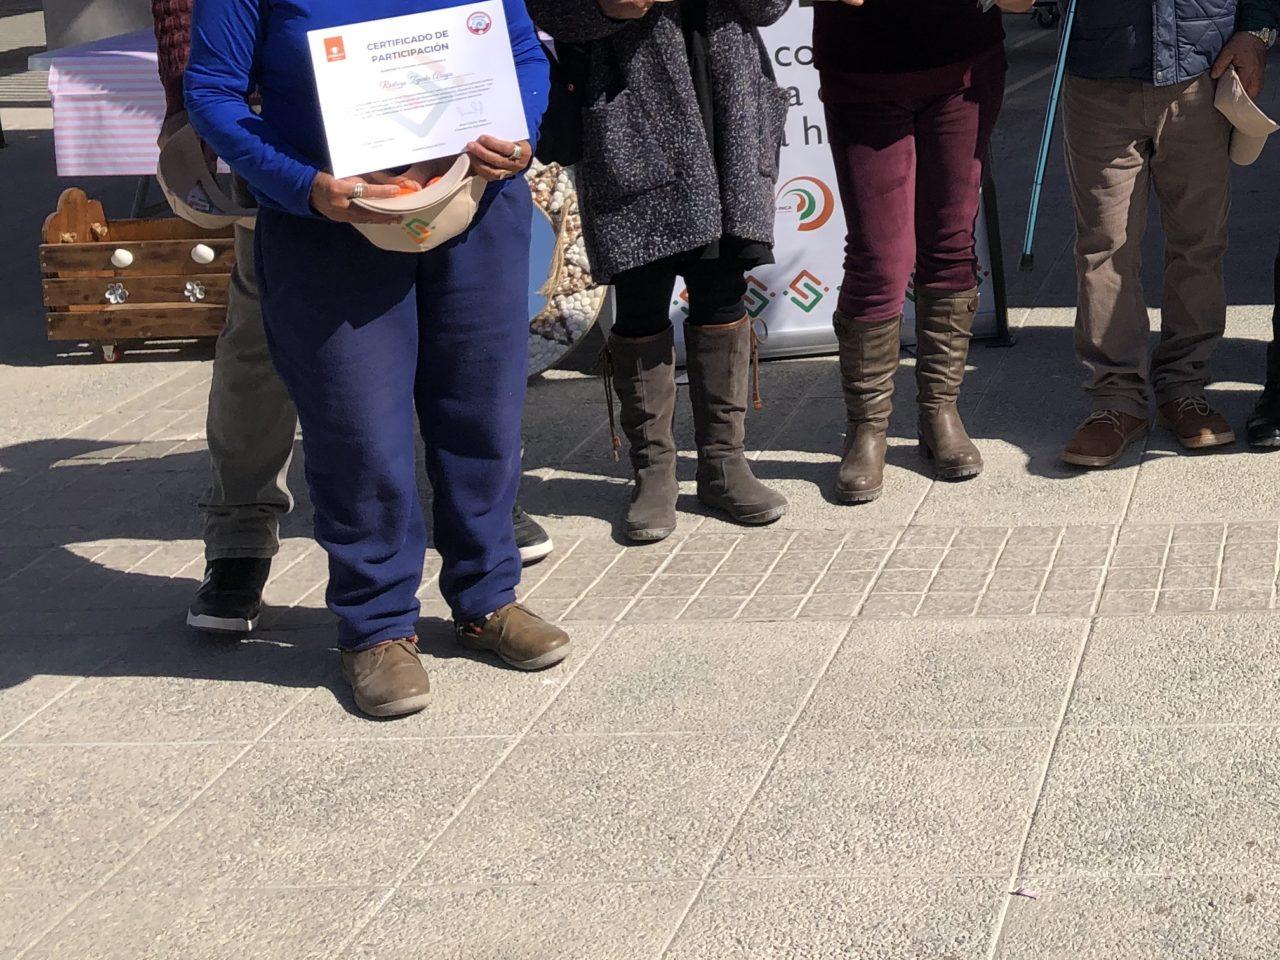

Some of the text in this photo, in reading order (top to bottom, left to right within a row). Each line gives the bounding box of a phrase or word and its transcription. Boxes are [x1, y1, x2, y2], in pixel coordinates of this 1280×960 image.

[366, 29, 450, 52] CERTIFICADO DE
[371, 42, 450, 63] PARTICIPACIÓN
